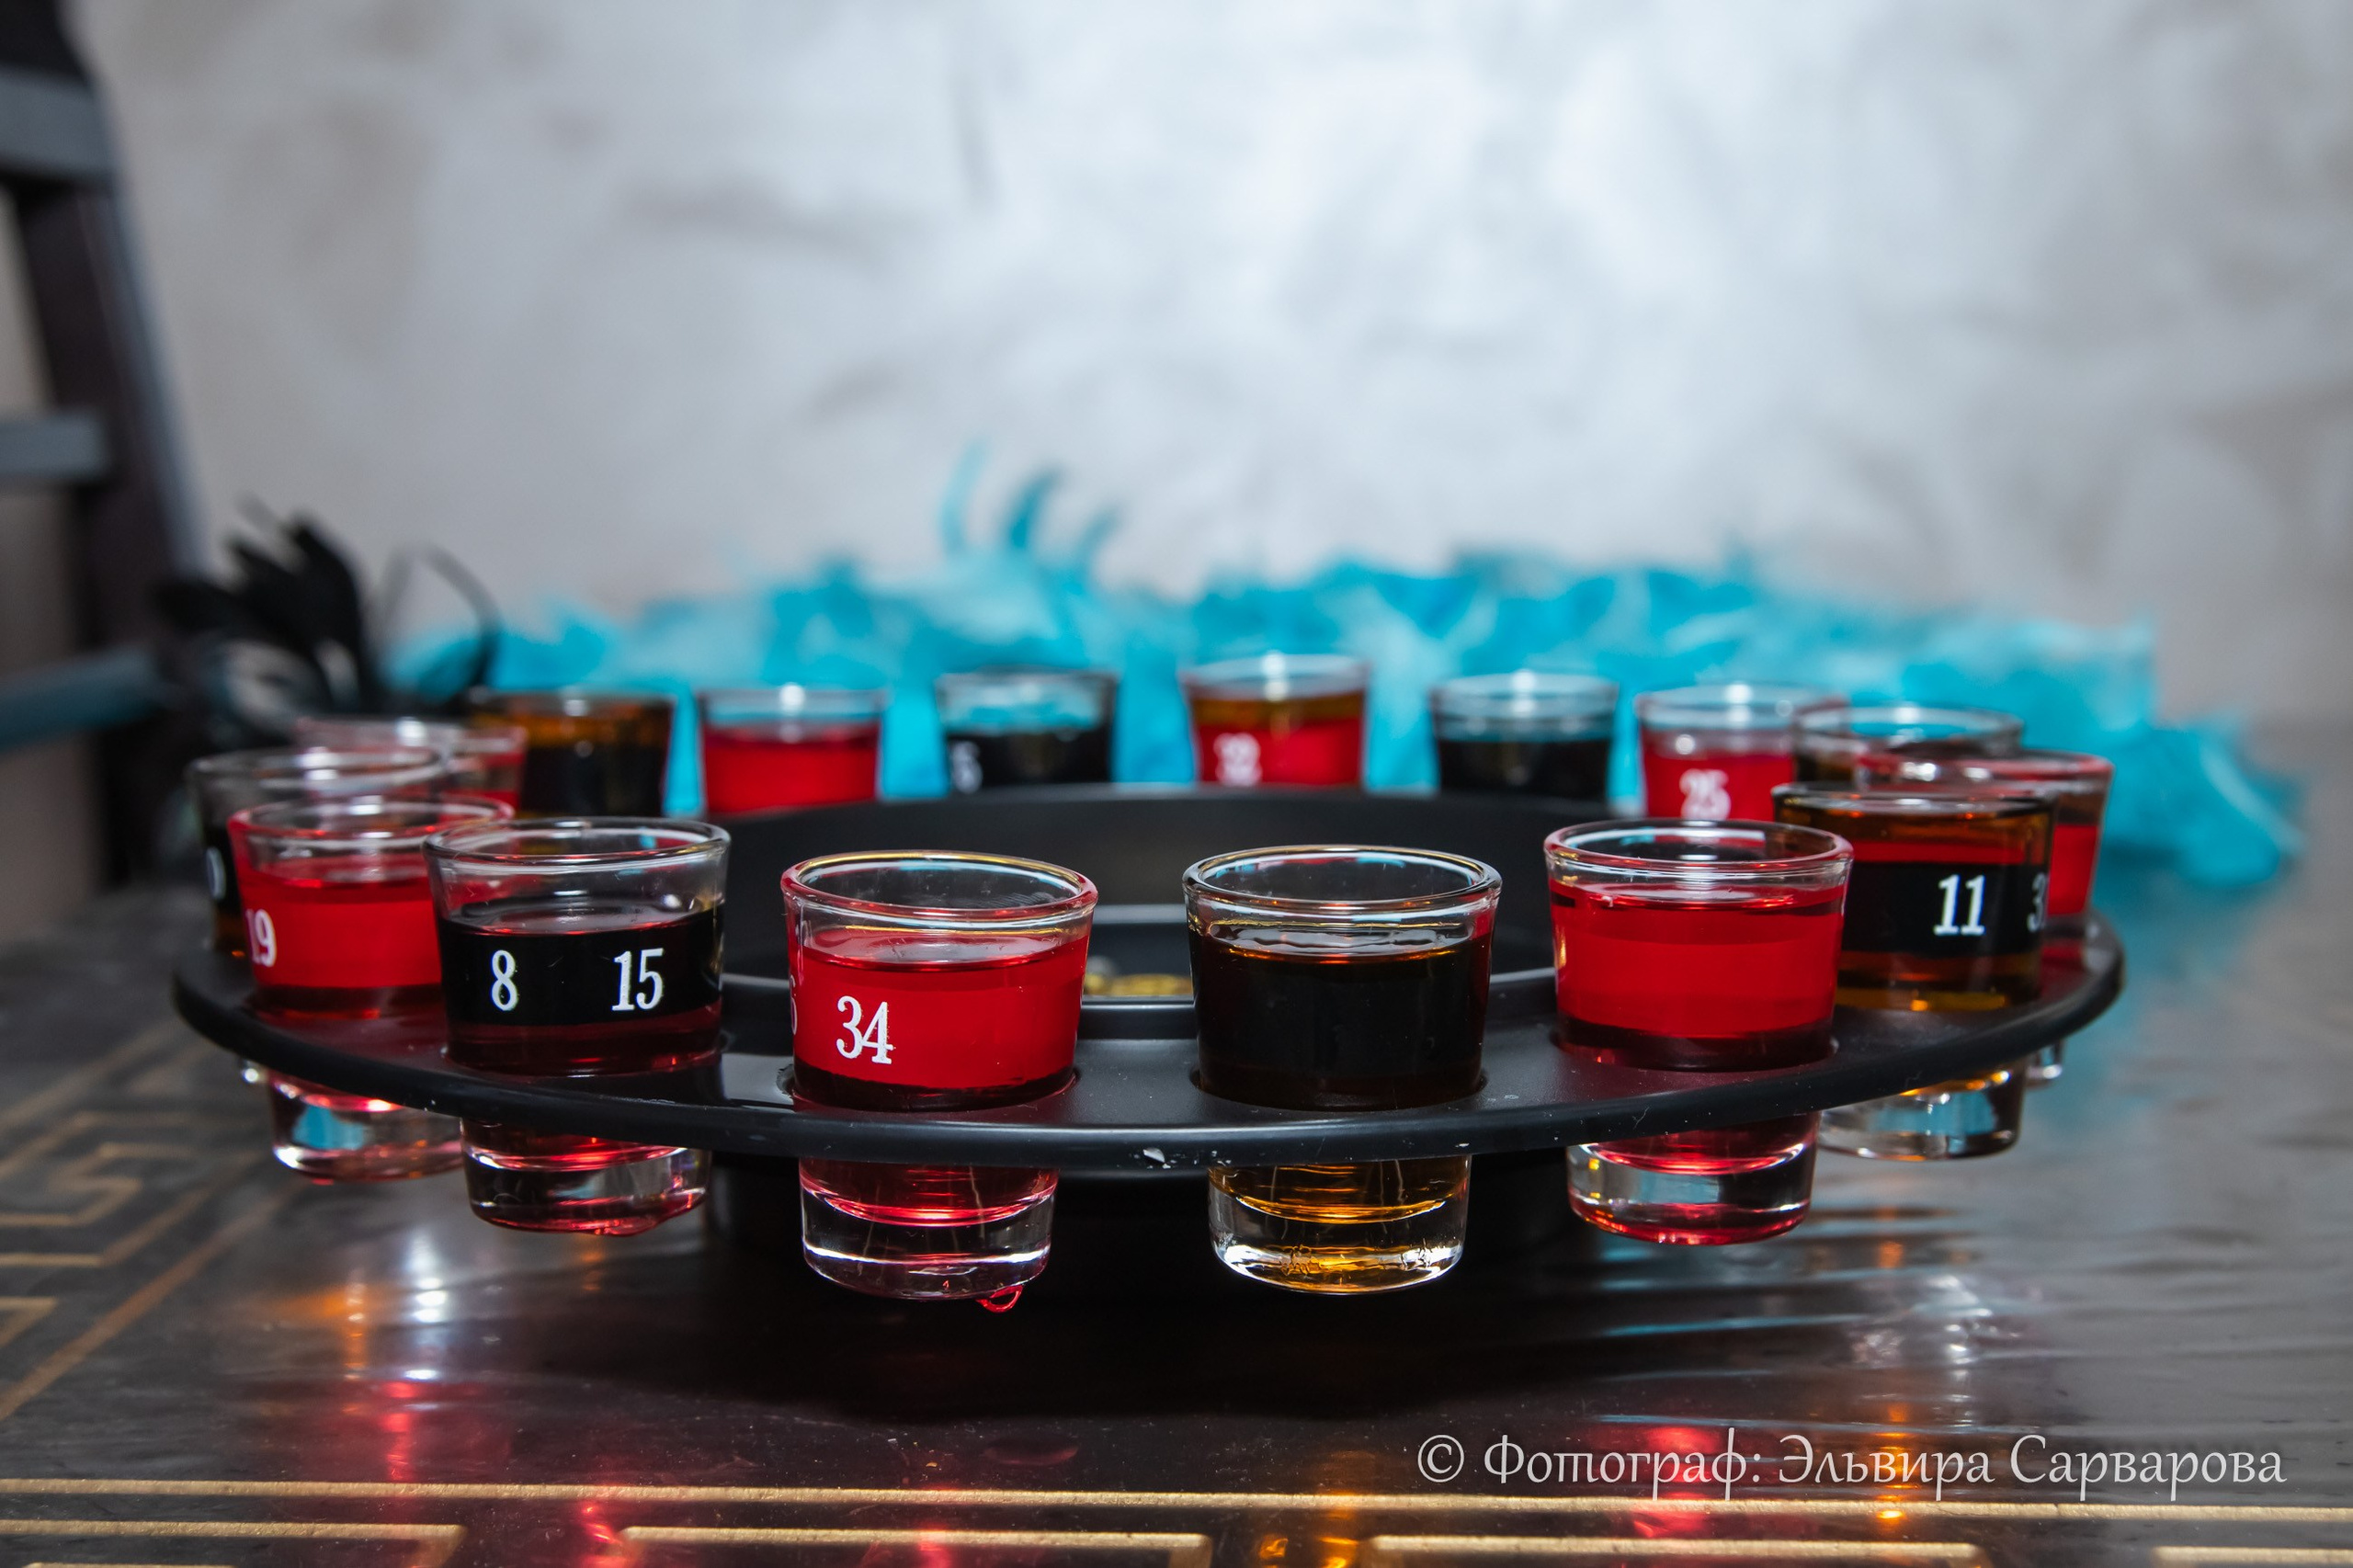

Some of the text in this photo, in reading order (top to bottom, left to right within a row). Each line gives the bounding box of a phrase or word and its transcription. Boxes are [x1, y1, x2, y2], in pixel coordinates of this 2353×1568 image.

[1933, 874, 1986, 936] 11
[245, 908, 278, 967] 19
[491, 948, 665, 1011] 8 15
[835, 995, 895, 1064] 34
